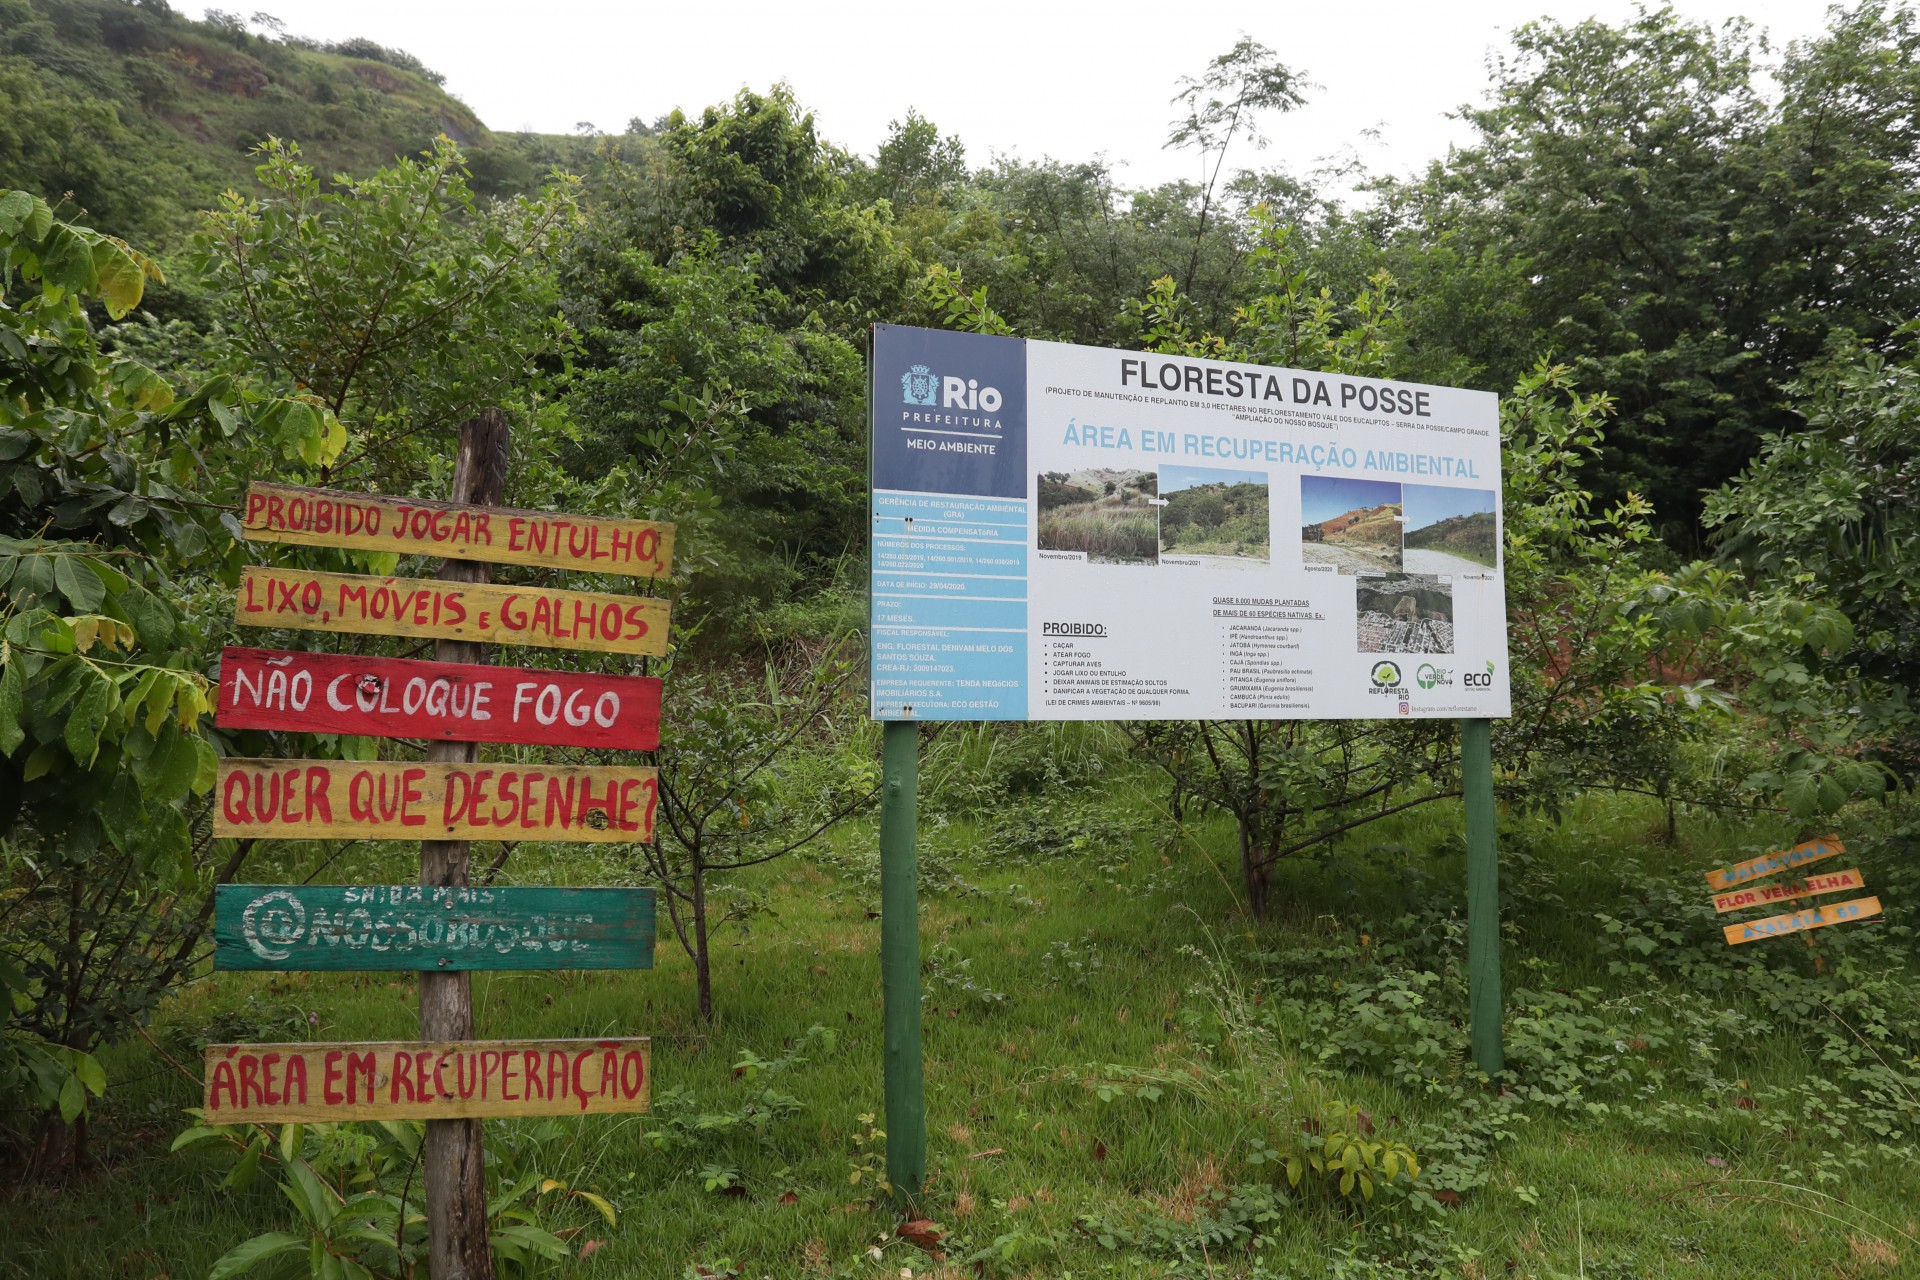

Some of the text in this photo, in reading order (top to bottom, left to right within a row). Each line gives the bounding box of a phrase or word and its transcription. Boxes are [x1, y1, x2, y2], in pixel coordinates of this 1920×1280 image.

[944, 376, 1002, 412] Rio
[1121, 359, 1431, 417] FLORESTA DA POSSE
[1046, 387, 1080, 397] (PROJETO
[1083, 390, 1092, 398] DE
[1094, 391, 1142, 403] MANUTENÇÃO
[1151, 397, 1188, 407] REPLANTIO
[1212, 403, 1246, 413] HECTARES
[1258, 407, 1321, 420] REFLORESTAMENTO
[1354, 417, 1389, 427] EUCALIPTOS
[1396, 421, 1415, 429] SERRA
[1426, 425, 1465, 434] POSSE/CAMPO
[903, 412, 1001, 428] PREFEITURA
[1285, 418, 1306, 426] NOSSO
[907, 438, 995, 455] MEIO AMBIENTE
[1063, 418, 1479, 478] ÁREA EM RECUPERAÇÃO AMBIENTAL
[879, 497, 916, 506] GERÊNCIA
[931, 501, 984, 511] RESTAURAÇÃO
[987, 505, 1026, 513] AMBIENTAL
[944, 511, 964, 519] (GRA)
[246, 492, 664, 573] PROIBIDO JOGAR ENTULHO,
[908, 525, 935, 533] MEDIDA
[245, 575, 650, 642] LIXO, MÓVEIS E GALHOS
[901, 629, 949, 637] RESPONSÁVEL:
[1043, 622, 1107, 635] PROIBIDO:
[1111, 679, 1143, 687] ESTIMAÇÃO
[1464, 673, 1491, 686] eco
[230, 657, 621, 730] NÃO COLOQUE FOGO
[1092, 688, 1126, 696] VEGETAÇÃO
[969, 700, 998, 708] GESTÃO
[223, 767, 657, 843] QUER QUE DESENHE?
[1717, 893, 1757, 909] FLOR
[1744, 913, 1825, 938] ATALAIA
[210, 1041, 644, 1111] ÁREA EM RECUPERAÇÃO
